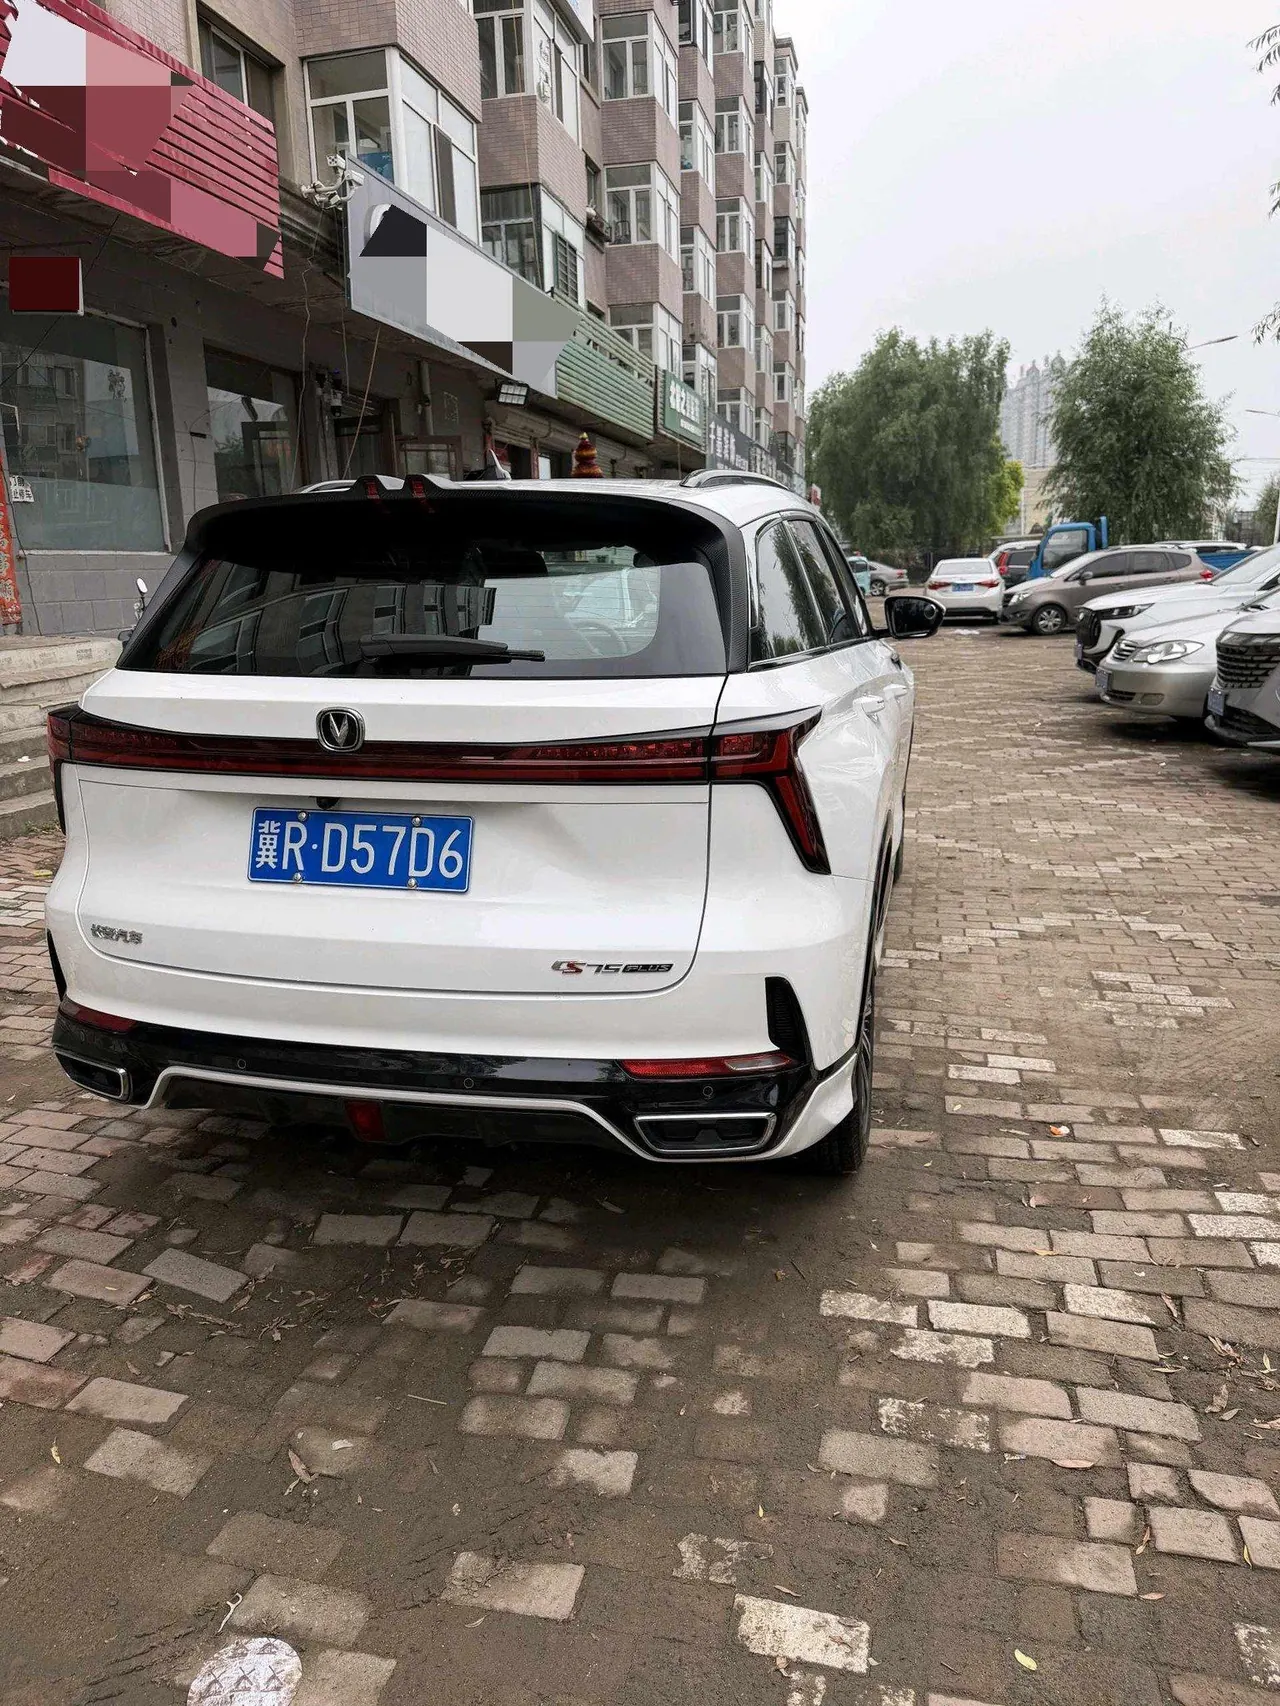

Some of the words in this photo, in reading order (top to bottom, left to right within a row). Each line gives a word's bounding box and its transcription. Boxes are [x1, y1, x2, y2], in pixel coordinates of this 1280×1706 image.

[255, 820, 464, 879] 冀R·D57D6
[551, 960, 623, 974] CS75
[622, 963, 674, 973] PLUS
